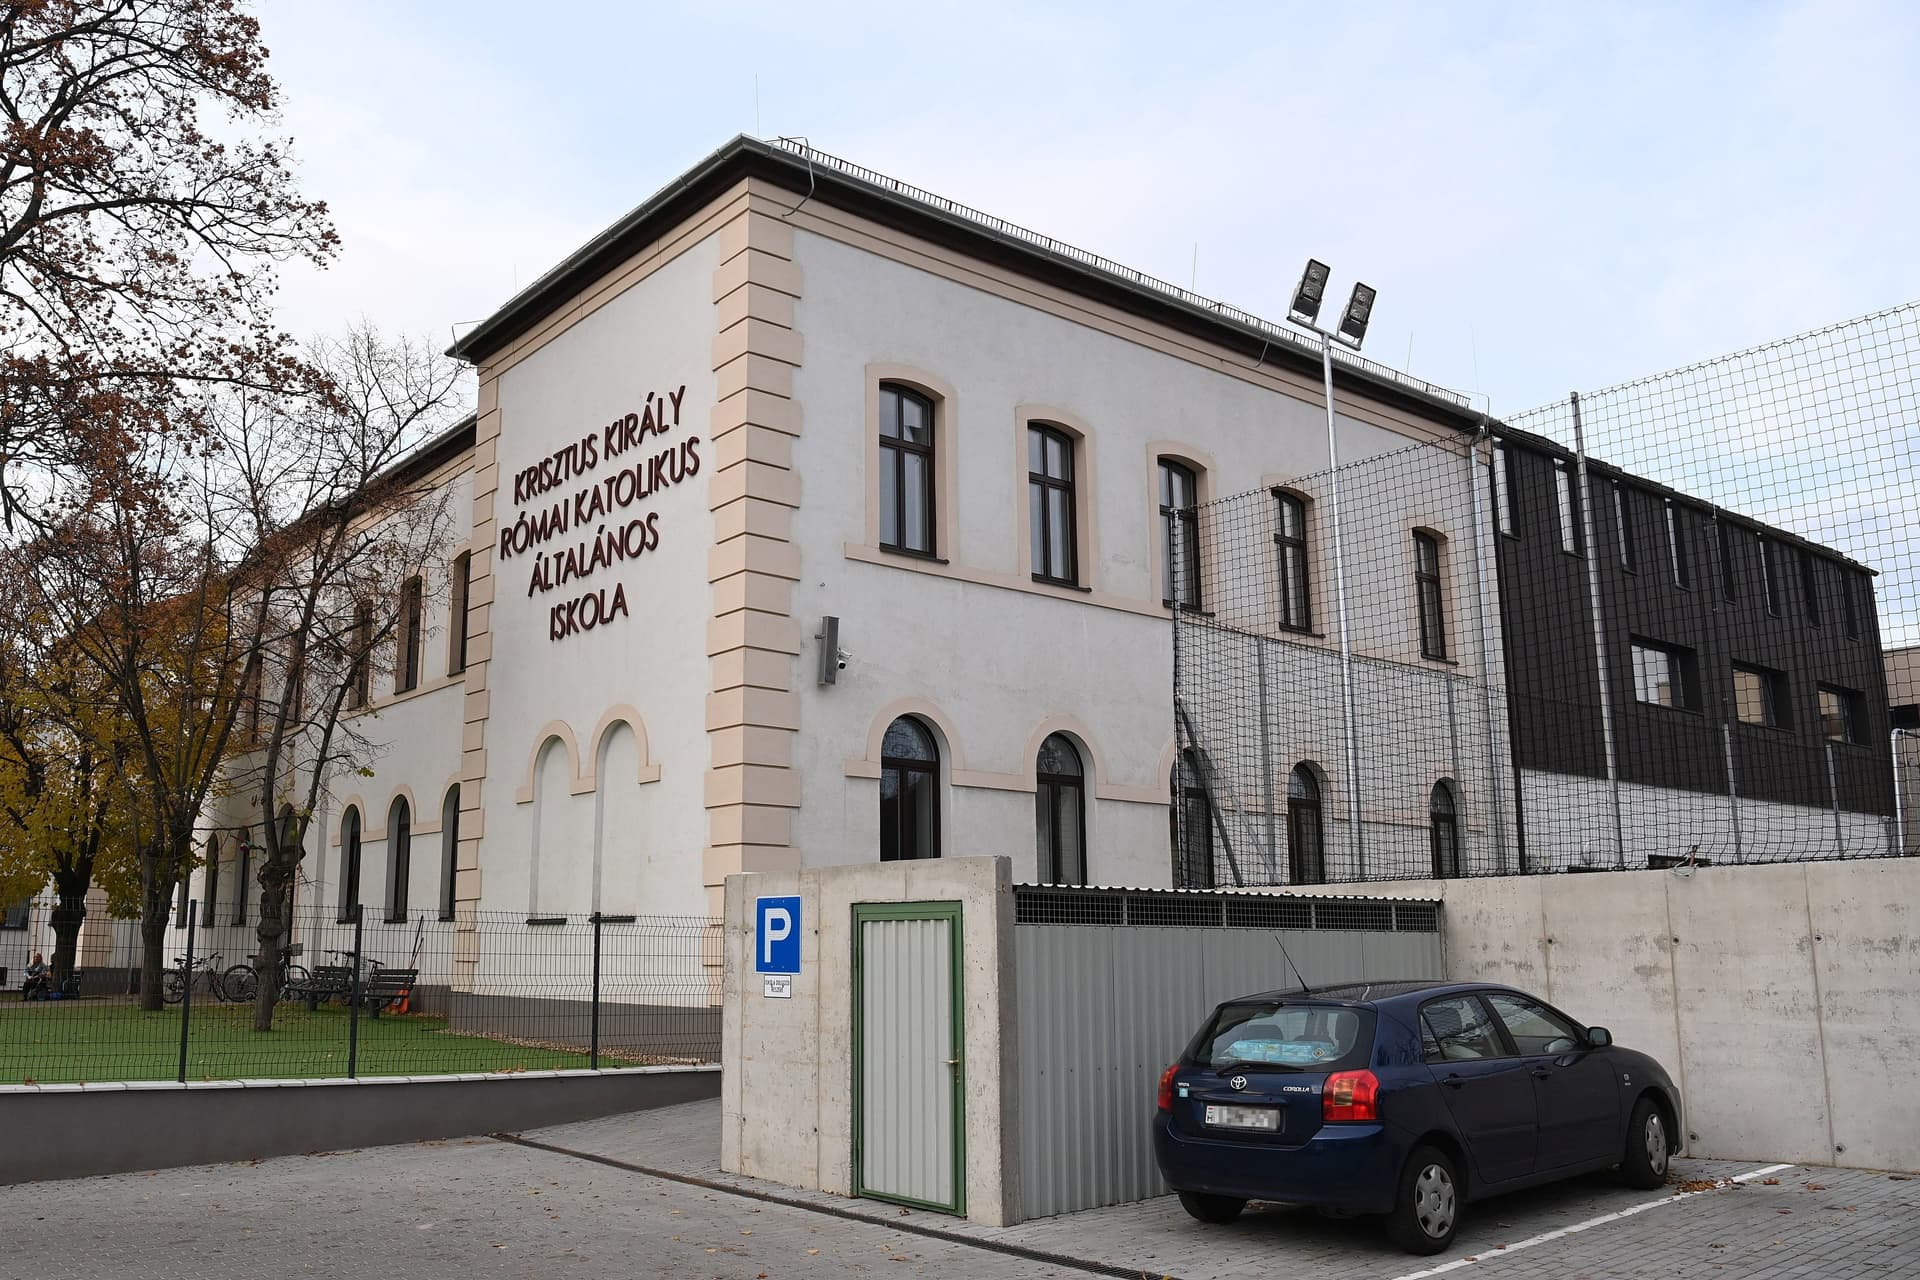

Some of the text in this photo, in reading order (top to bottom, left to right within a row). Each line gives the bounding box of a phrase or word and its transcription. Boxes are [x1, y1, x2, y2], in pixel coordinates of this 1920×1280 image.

[513, 384, 686, 506] KRISZTUS KIRÁLY
[499, 436, 700, 561] RÓMAI KATOLIKUS
[527, 511, 660, 599] ÁLTALÁNOS
[549, 582, 630, 642] ISKOLA
[764, 907, 792, 963] P
